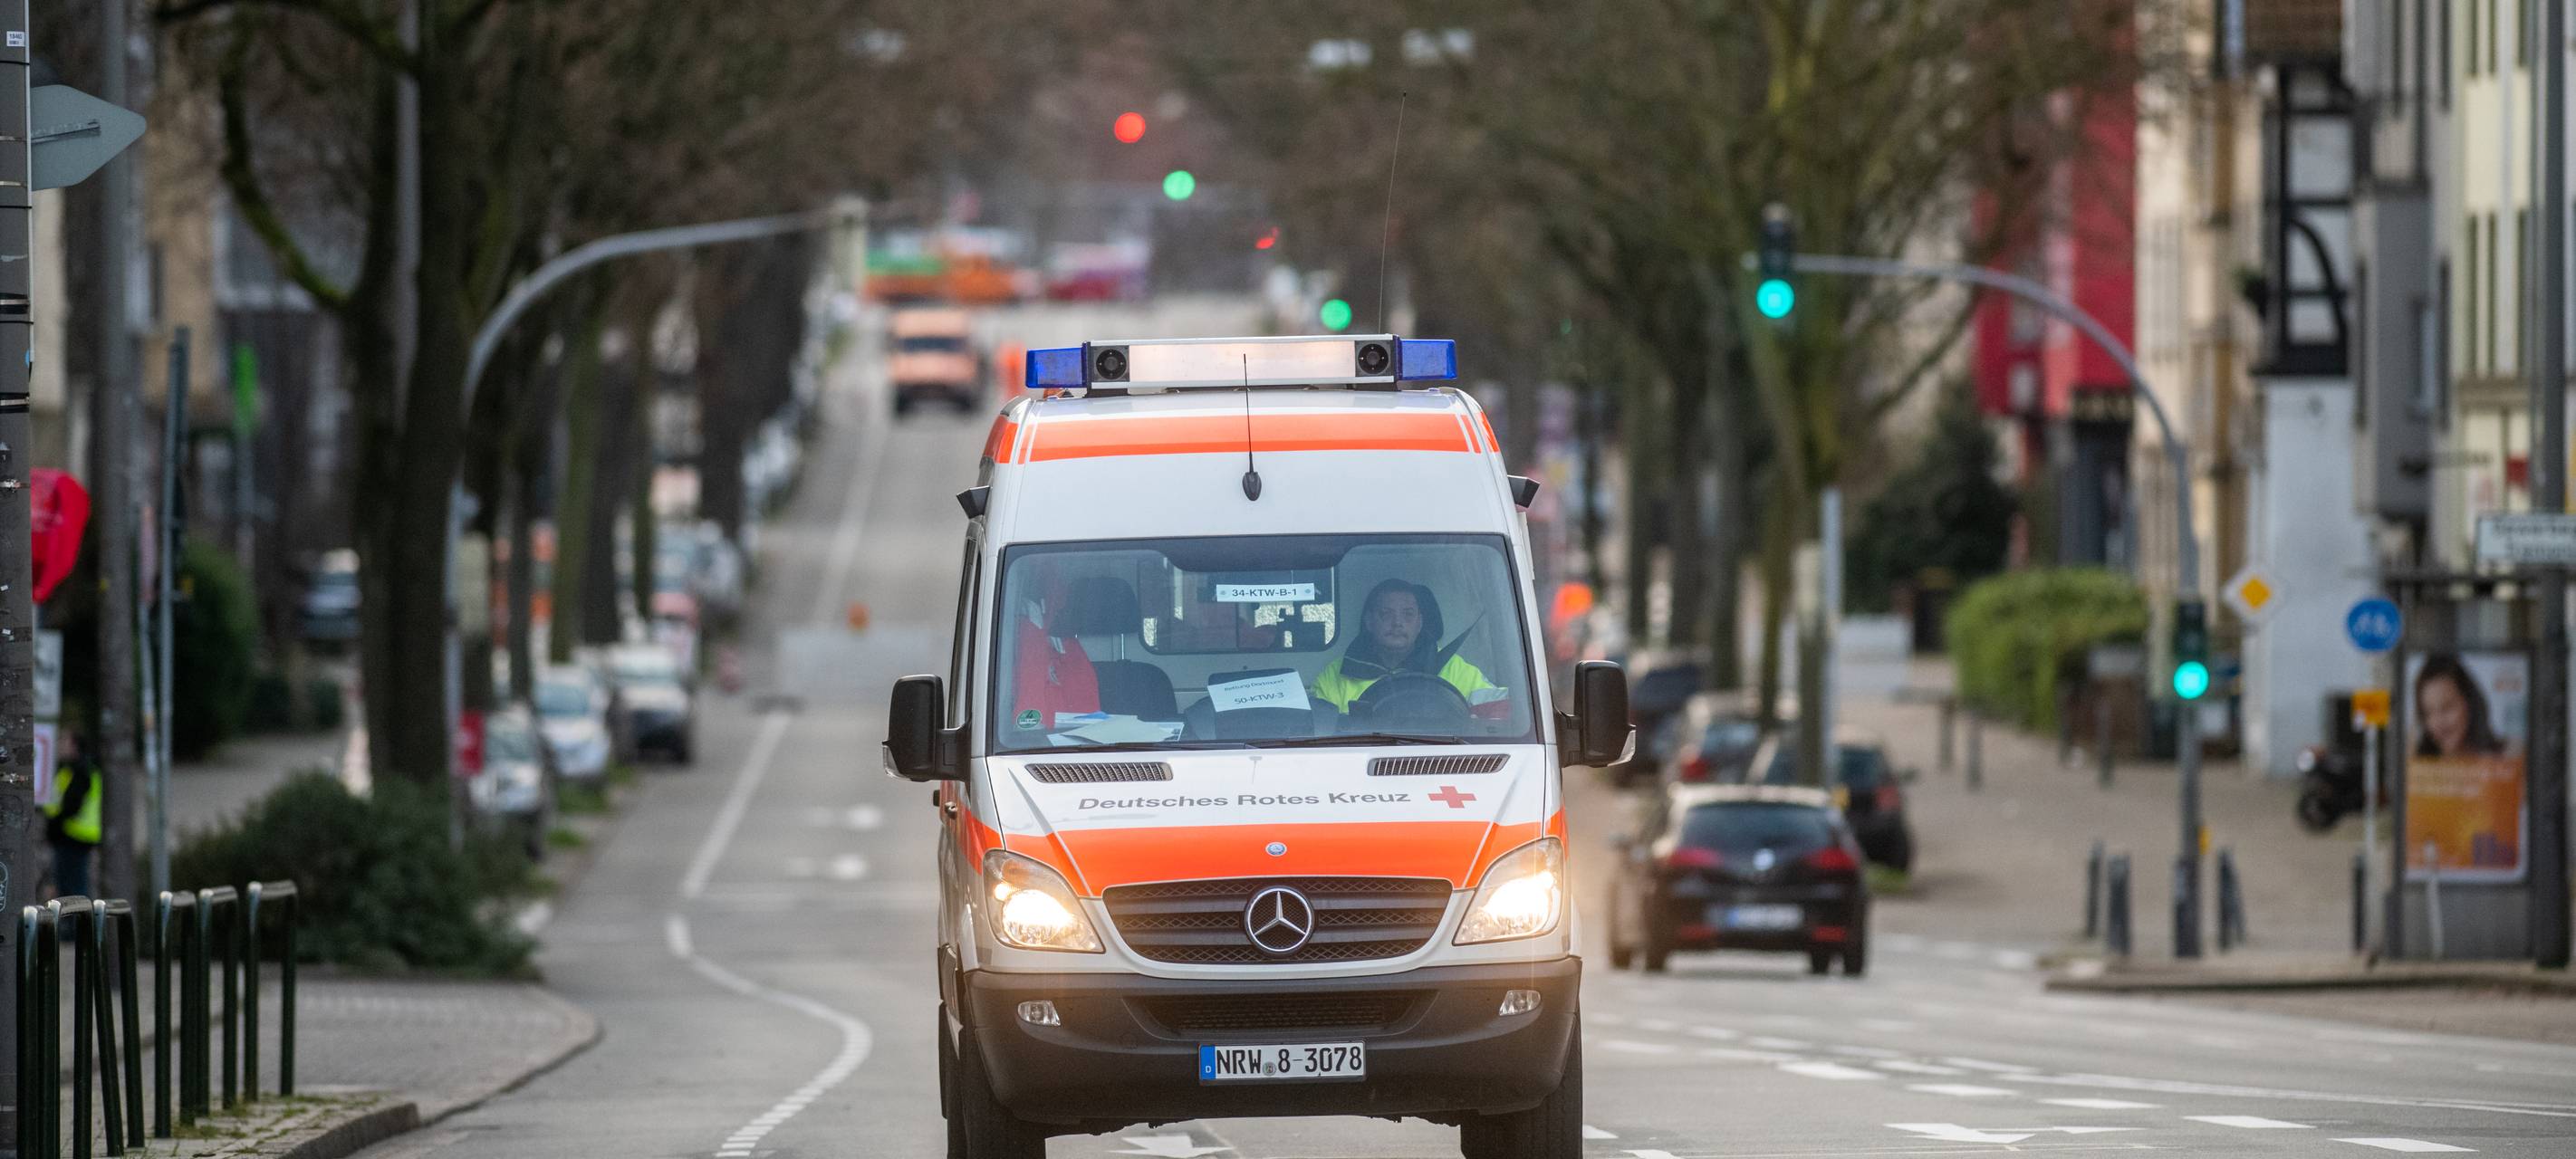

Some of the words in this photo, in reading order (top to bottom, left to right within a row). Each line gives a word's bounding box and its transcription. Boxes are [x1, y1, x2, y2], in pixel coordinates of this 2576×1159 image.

[1232, 589, 1297, 597] 34-KTW-B-1
[1235, 692, 1284, 704] 50-KTW-3
[1078, 796, 1228, 809] Deutsches
[1237, 794, 1320, 806] Rotes
[1329, 792, 1411, 804] Kreuz
[1216, 1049, 1262, 1075] NRW
[1277, 1046, 1363, 1074] 8-3078
[1205, 1065, 1212, 1073] D
